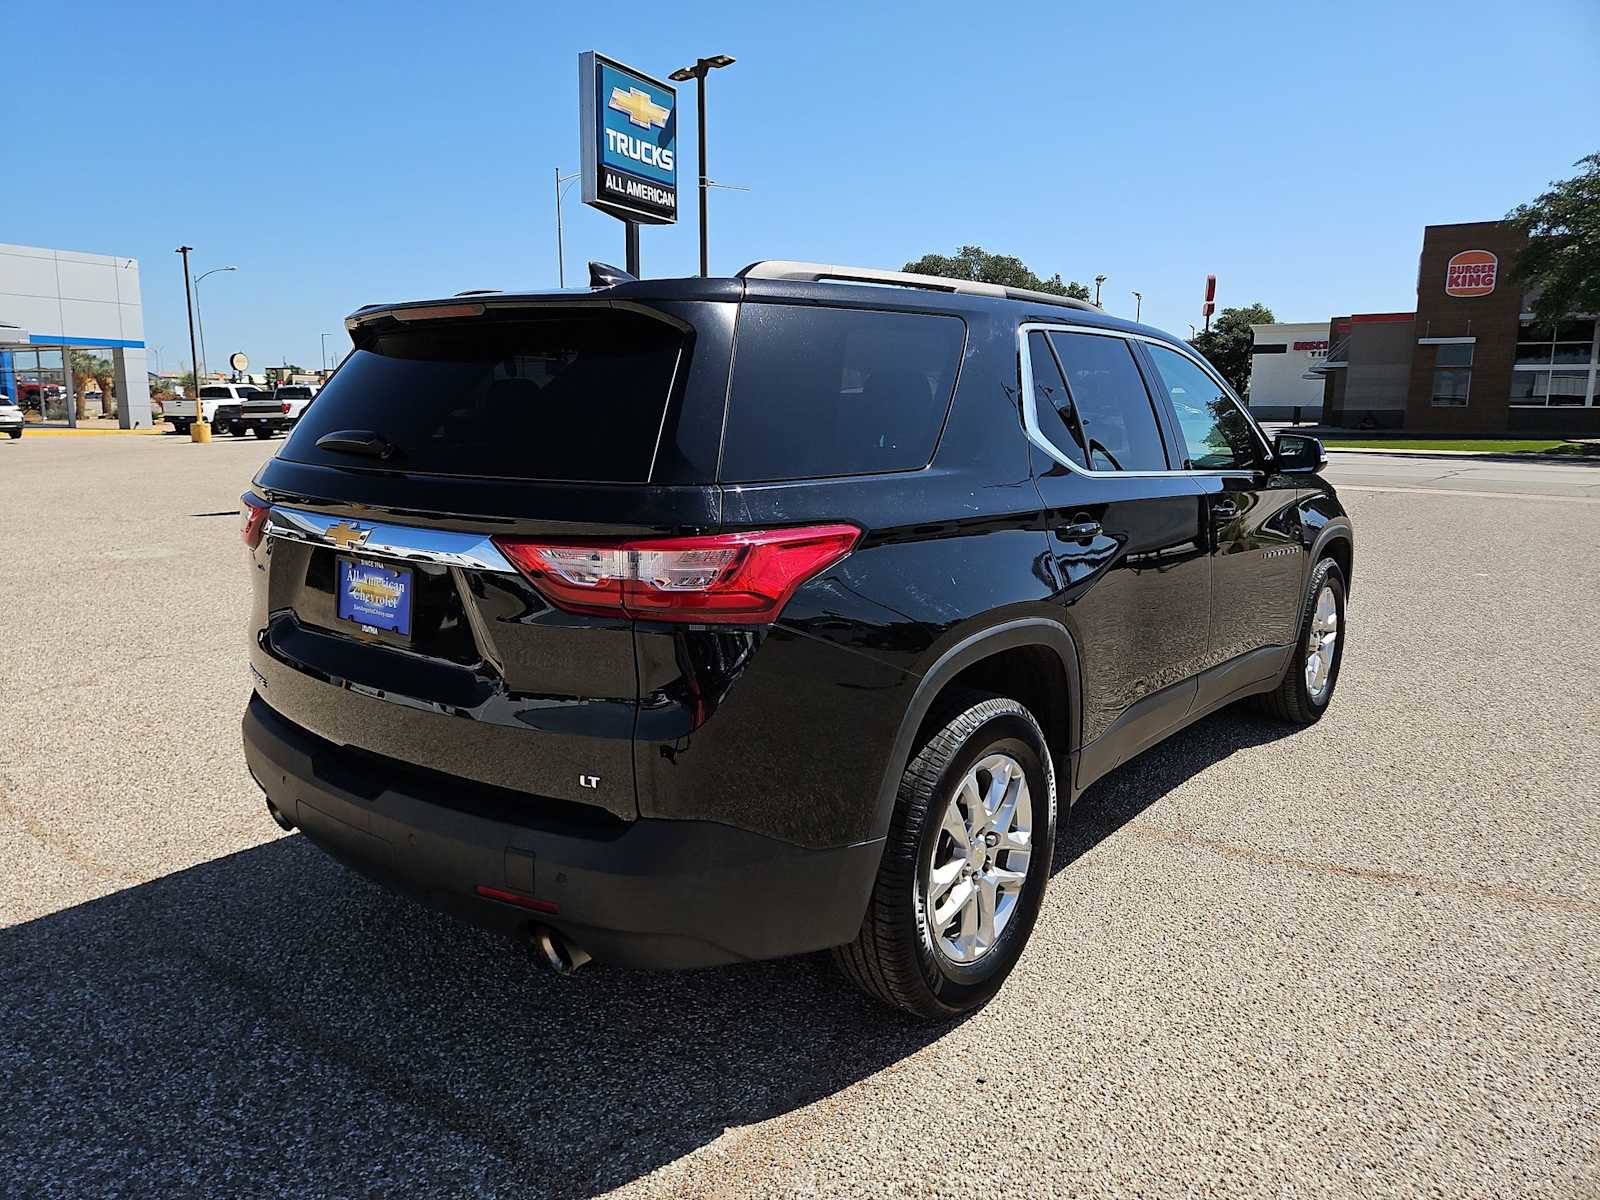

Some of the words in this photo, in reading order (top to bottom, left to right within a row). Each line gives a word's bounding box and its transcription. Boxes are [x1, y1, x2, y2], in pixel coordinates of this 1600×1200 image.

[605, 128, 673, 171] TRUCKS
[605, 173, 625, 194] ALL
[626, 181, 675, 208] AMERICAN
[1448, 274, 1494, 287] KING
[1449, 264, 1495, 275] BURGER
[347, 569, 360, 582] All
[361, 572, 405, 593] American
[352, 586, 398, 609] Chevrolet
[579, 775, 601, 789] LT
